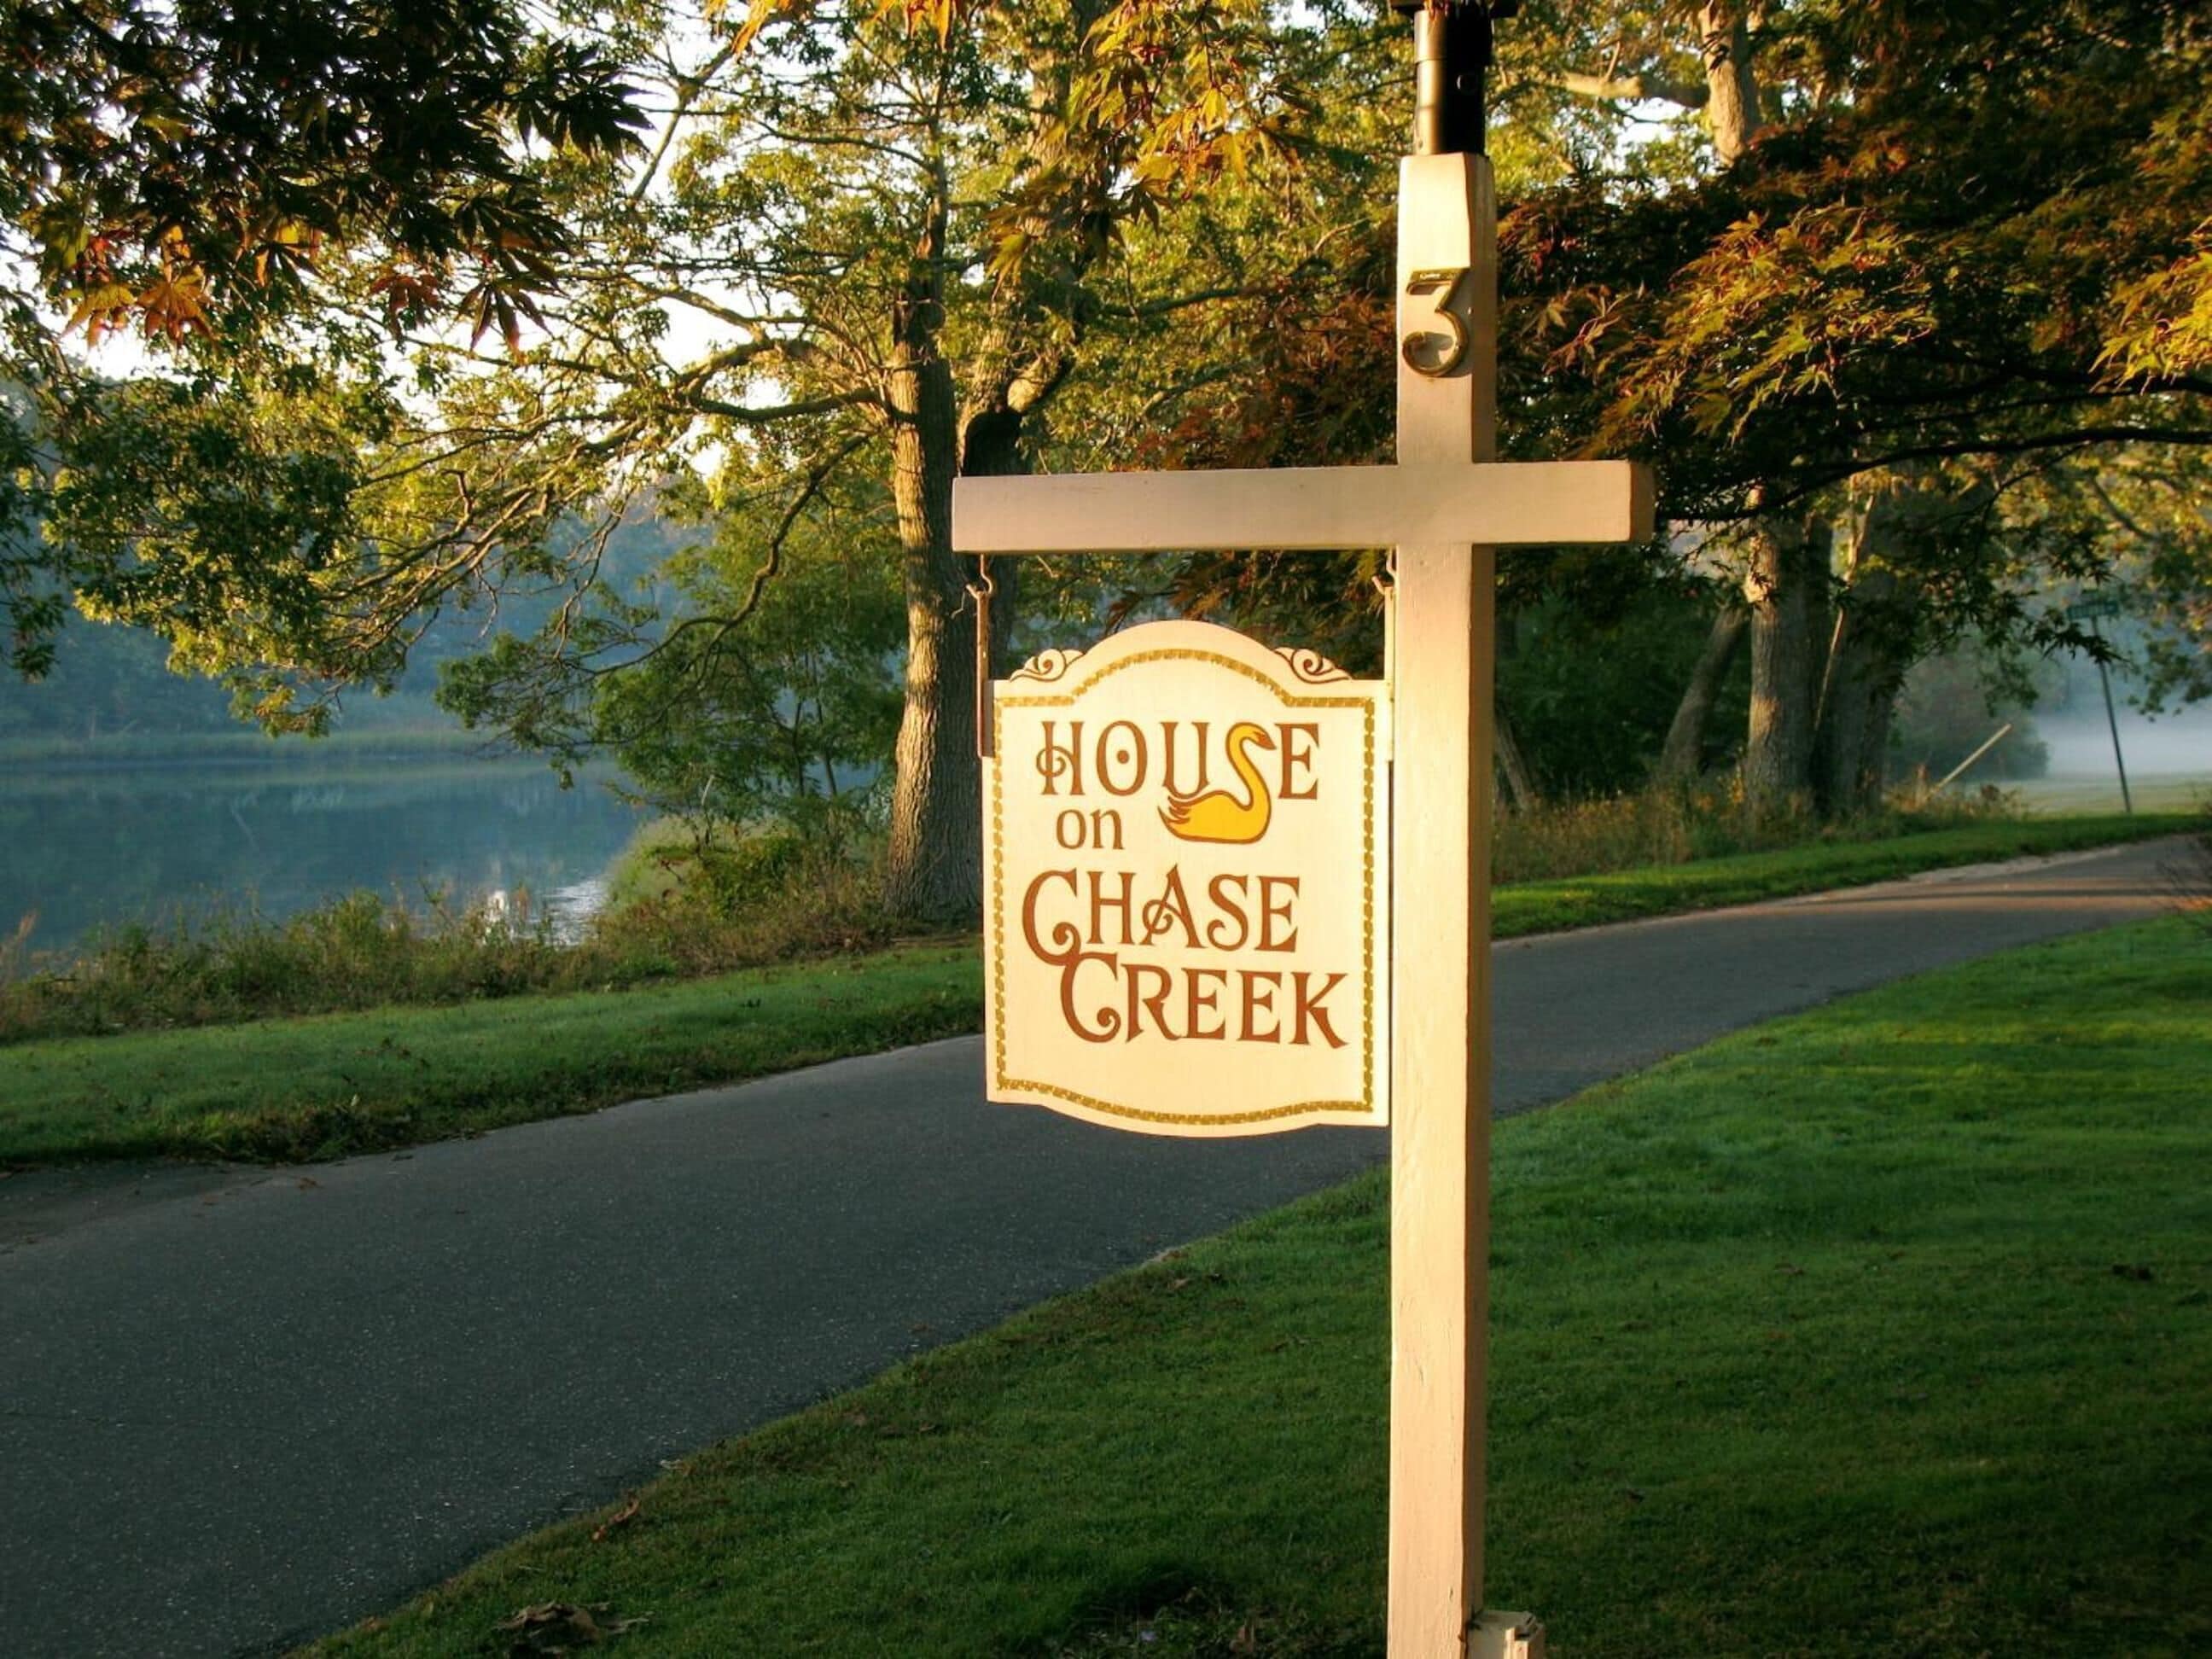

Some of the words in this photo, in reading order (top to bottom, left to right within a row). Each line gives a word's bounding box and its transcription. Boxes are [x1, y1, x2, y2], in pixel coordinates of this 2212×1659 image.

[1402, 267, 1470, 377] 3
[1036, 720, 1319, 844] HOUSE
[1057, 808, 1124, 850] on
[1023, 864, 1301, 966] CHASE
[1061, 952, 1348, 1049] CREEK
